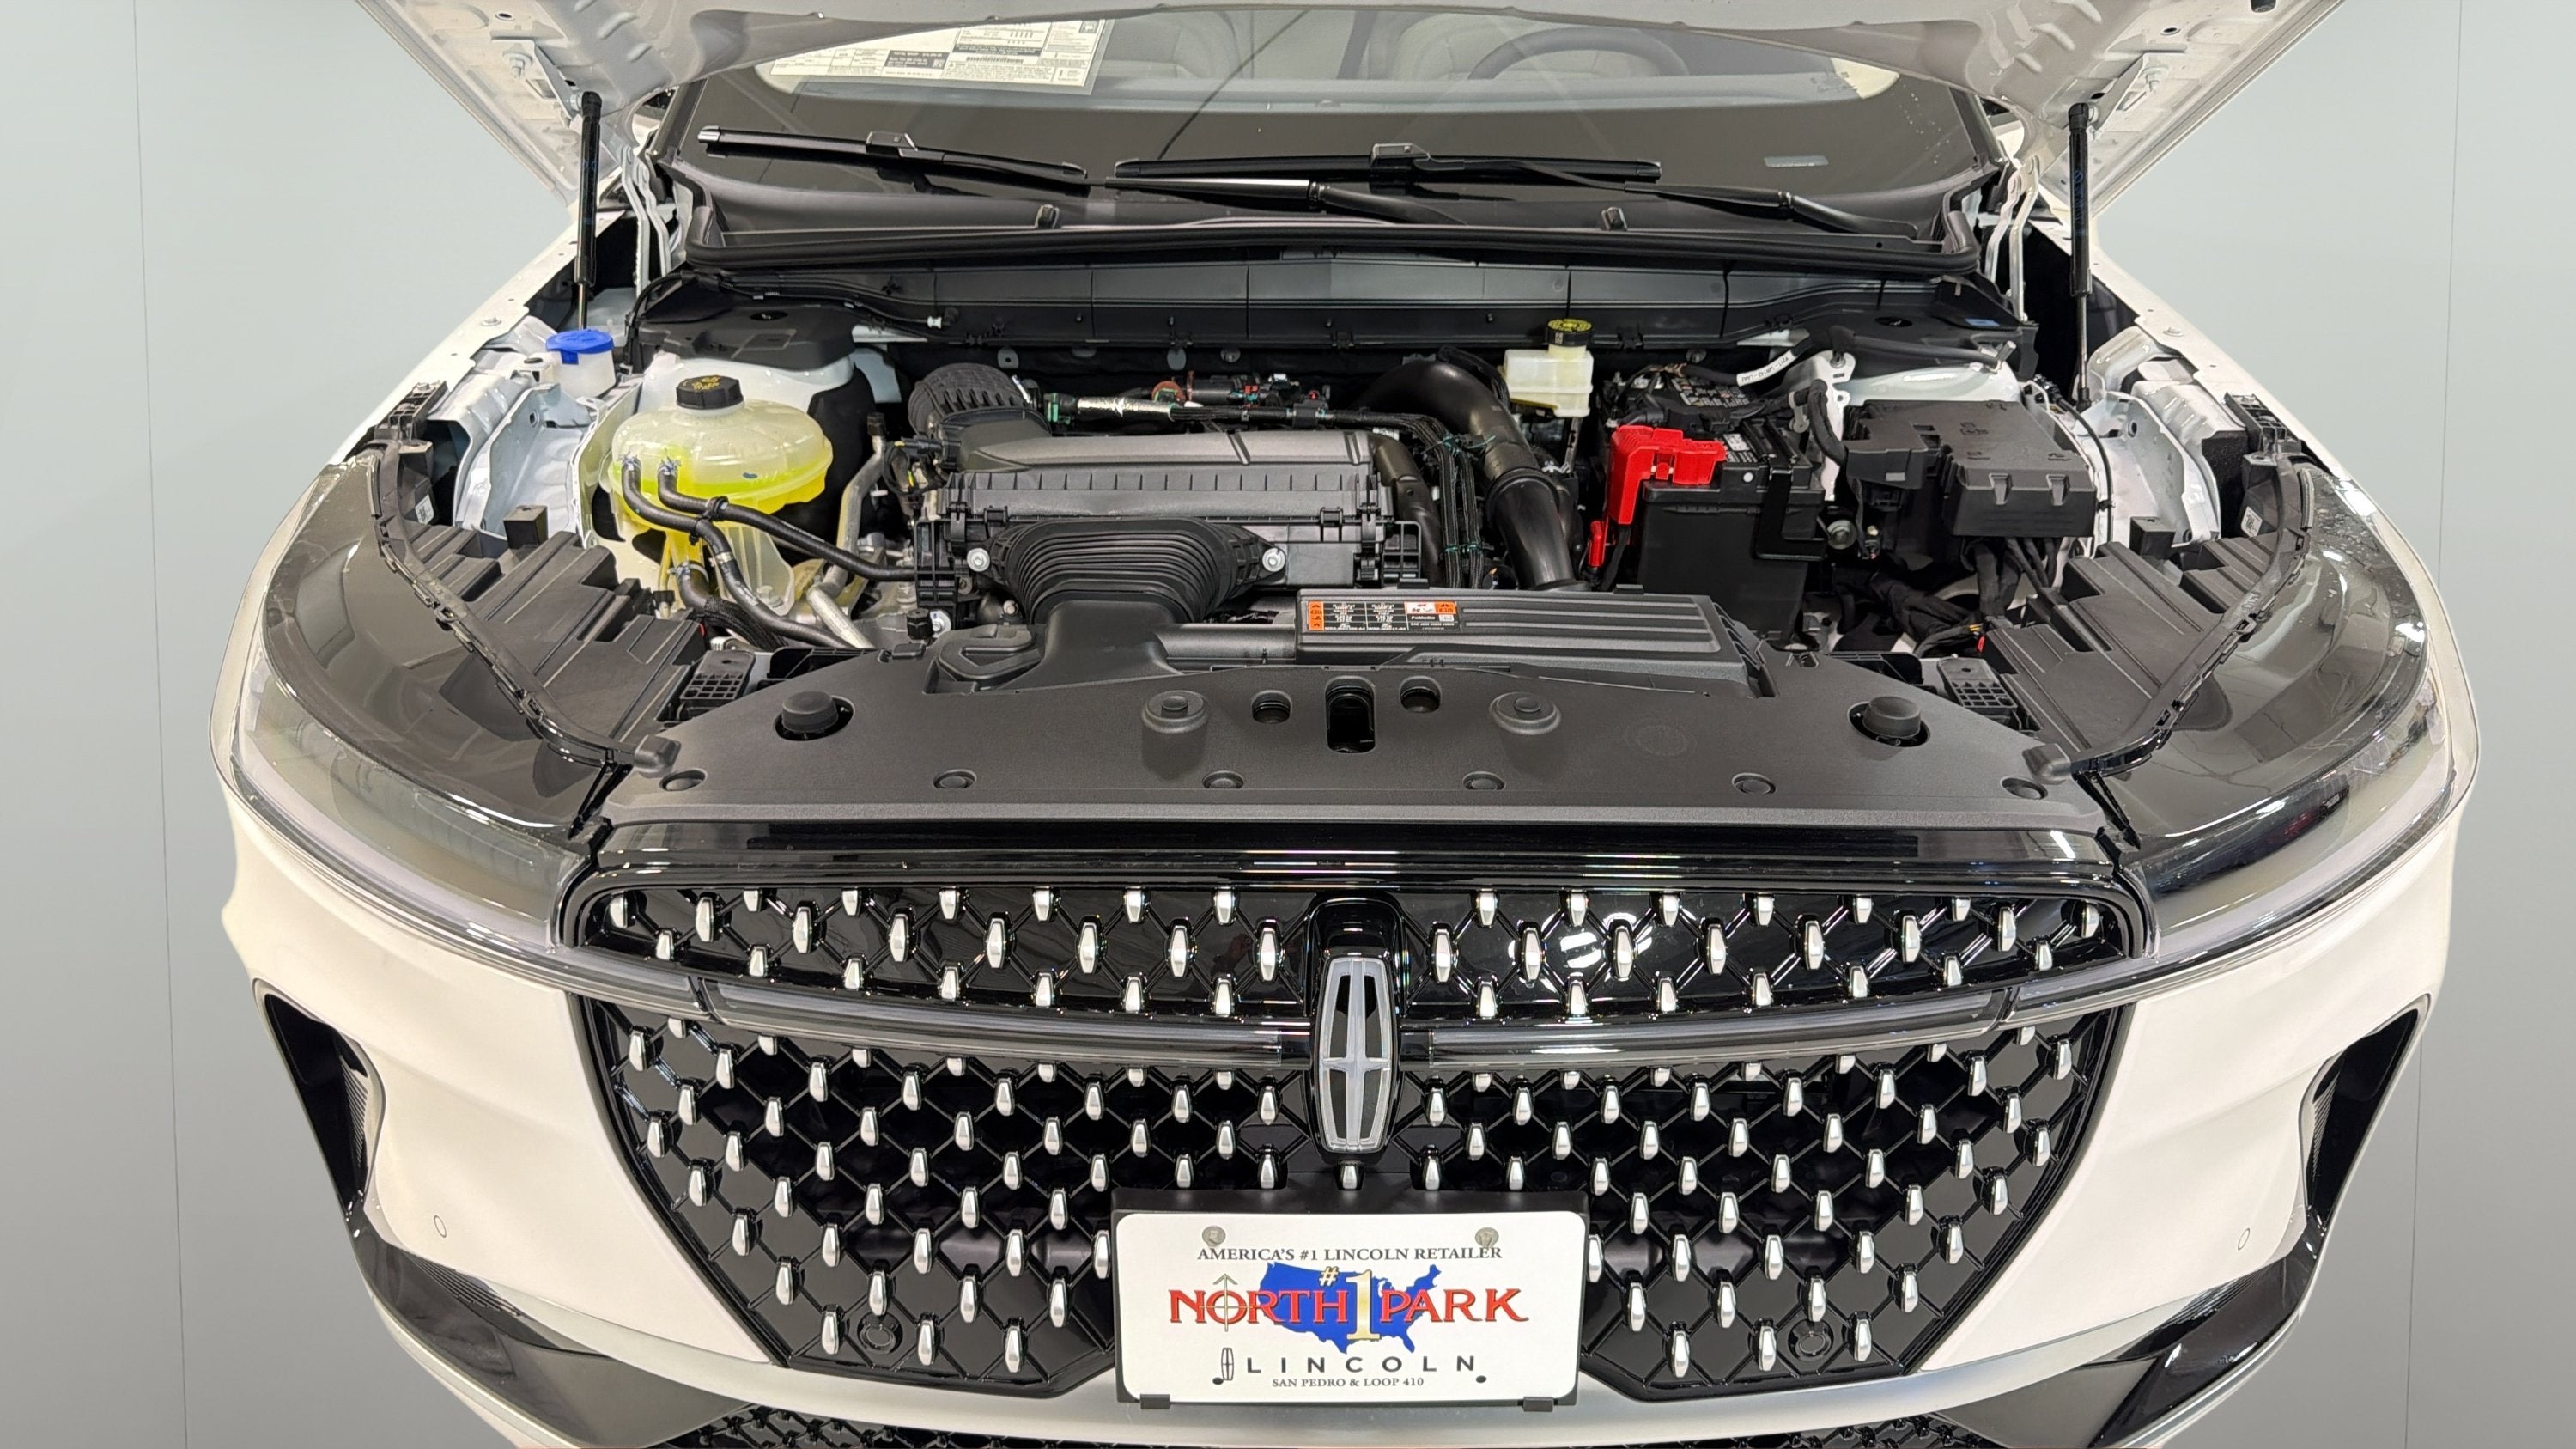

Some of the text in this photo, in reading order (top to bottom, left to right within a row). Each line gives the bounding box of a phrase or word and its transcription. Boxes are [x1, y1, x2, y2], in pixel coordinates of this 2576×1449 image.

[1197, 1246, 1503, 1261] AMERICA'S #1 LINCOLN RETAILER
[1168, 1288, 1530, 1324] NORTH PARK
[1246, 1355, 1476, 1374] LINCOLN
[1272, 1377, 1425, 1388] SAN PEDRO & LOOP 410
